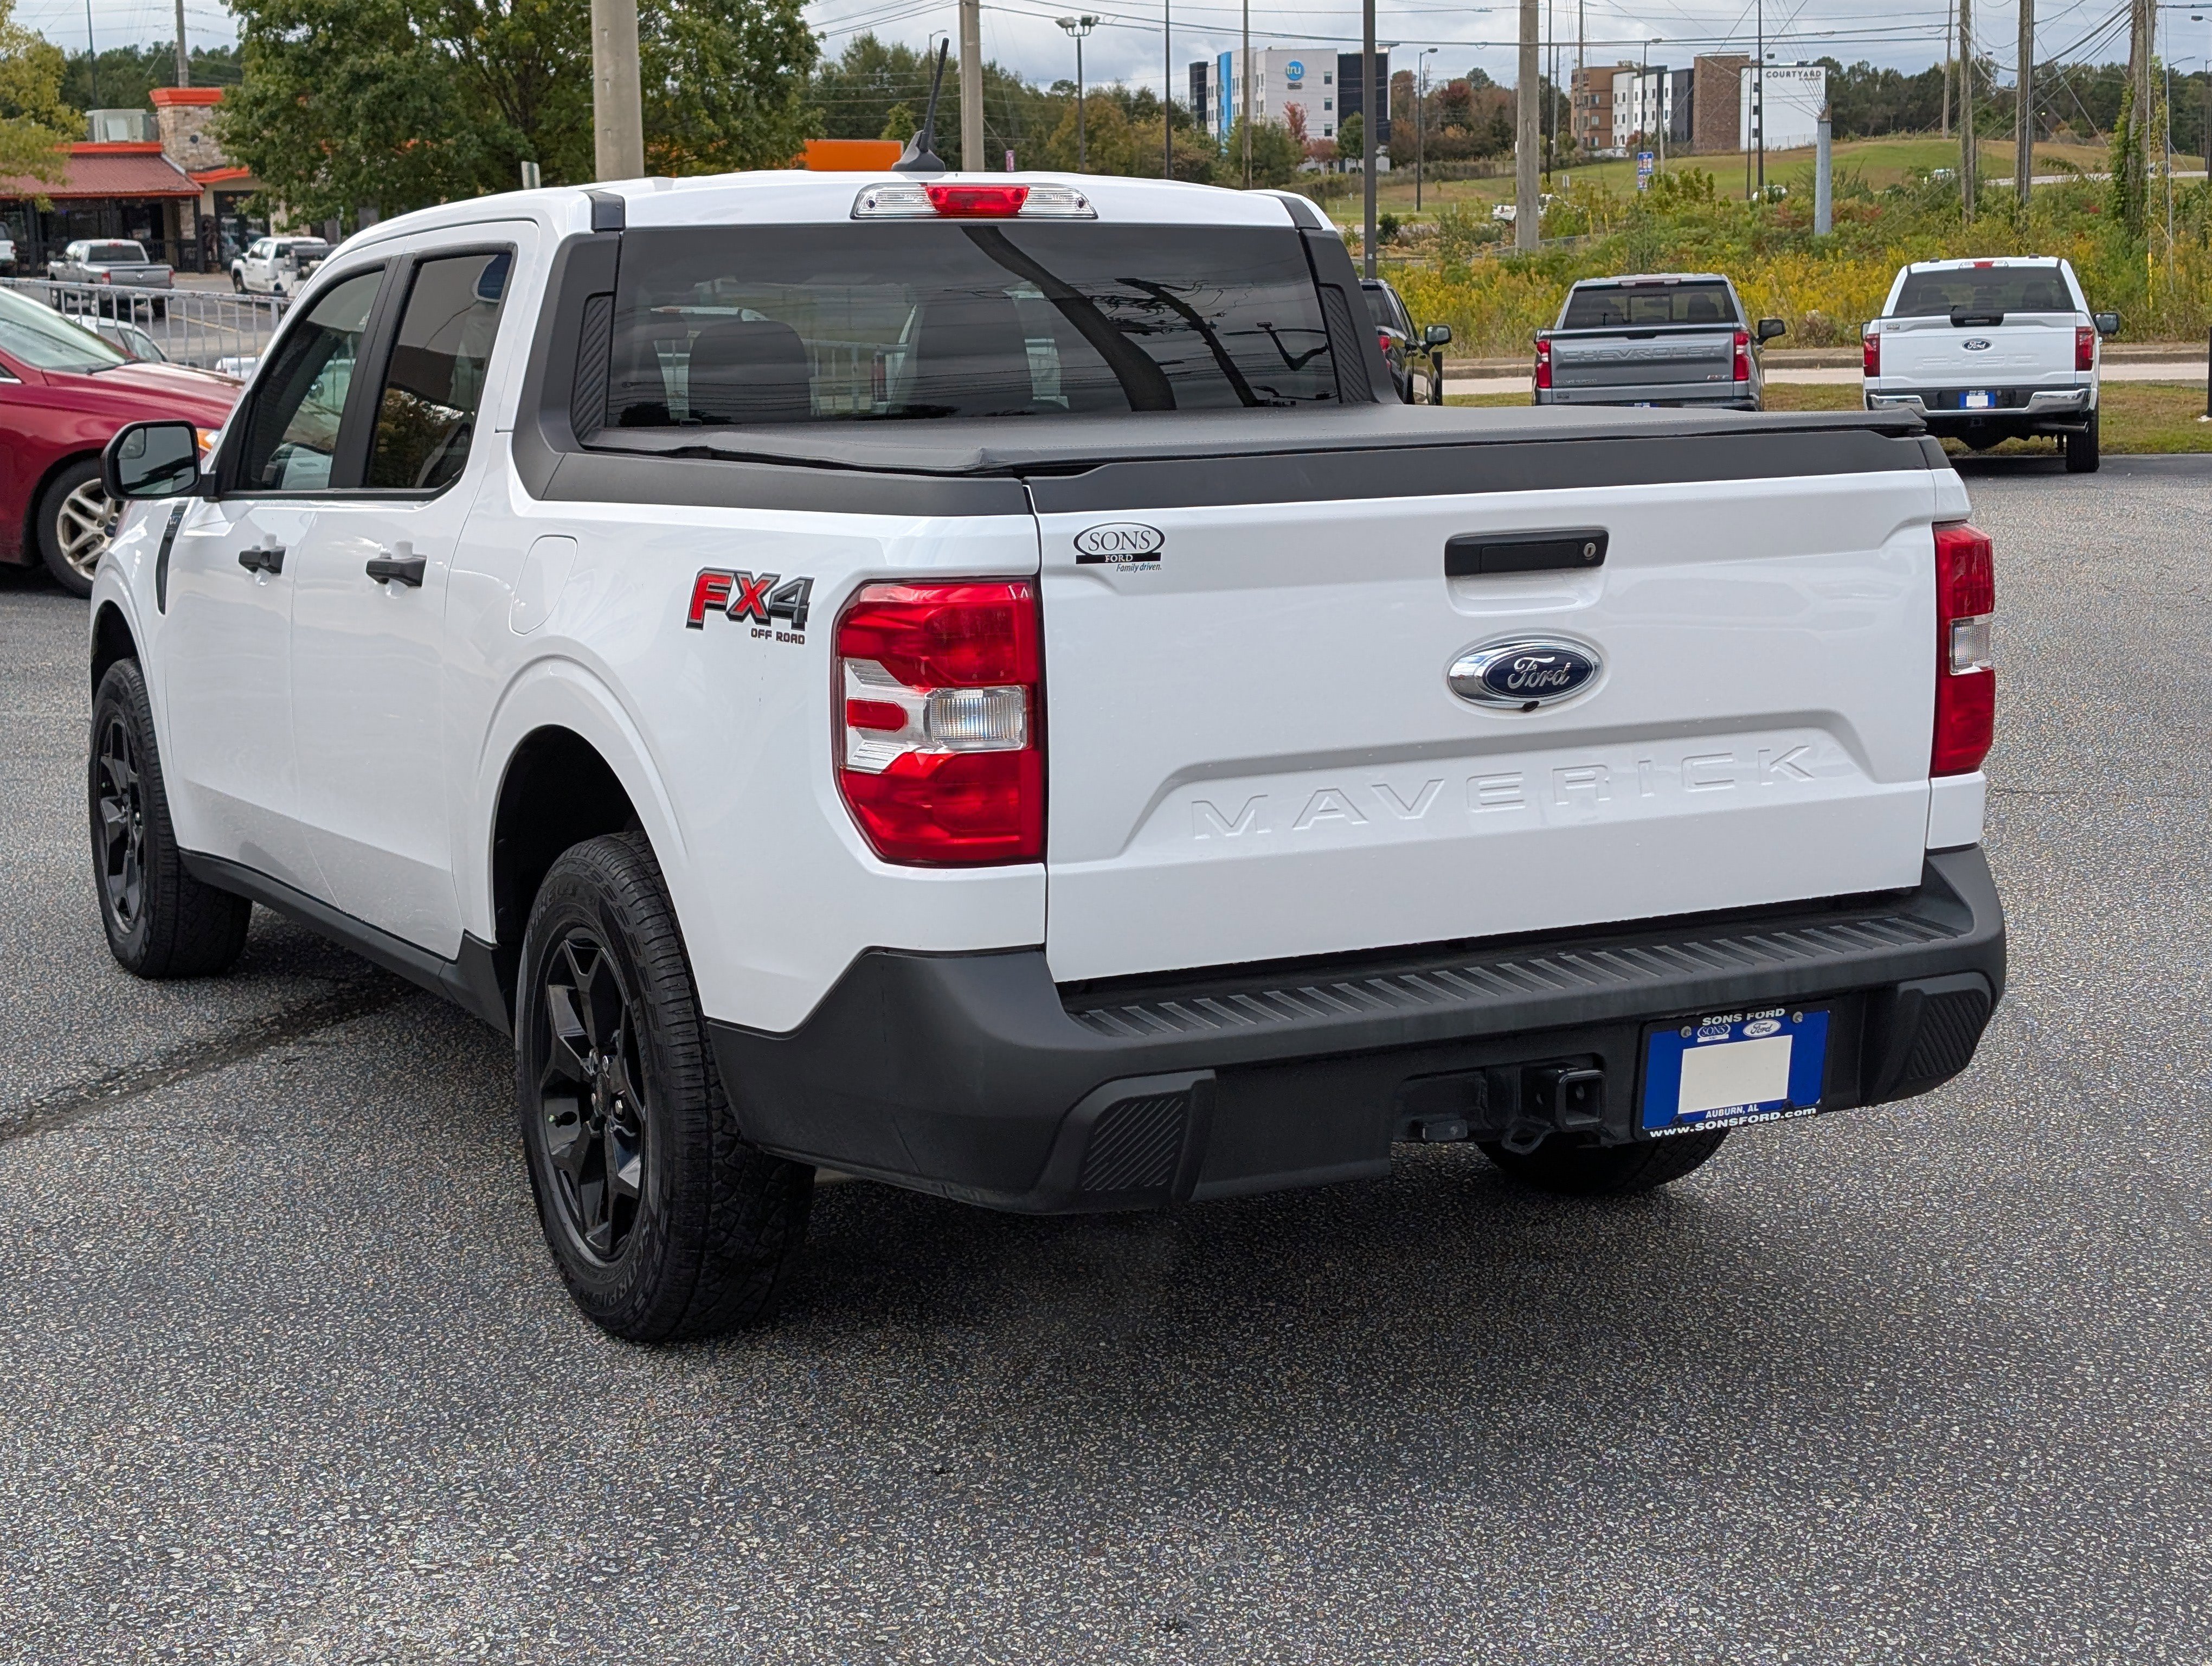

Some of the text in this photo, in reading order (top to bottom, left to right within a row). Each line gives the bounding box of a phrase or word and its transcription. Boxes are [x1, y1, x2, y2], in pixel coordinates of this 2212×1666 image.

[1287, 66, 1301, 74] tru
[1766, 70, 1821, 78] COURTYARD
[1967, 340, 1986, 349] Ford
[1563, 346, 1721, 362] CHEVROLET
[1088, 530, 1151, 552] SONS
[1104, 554, 1133, 562] FORD
[1116, 563, 1162, 573] Family driven.
[685, 566, 815, 631] FX4
[751, 628, 805, 645] OFF ROAD
[1507, 656, 1571, 689] Ford
[1191, 745, 1816, 840] MAVERICK
[1702, 1008, 1785, 1026] SONS FORD
[1701, 1024, 1726, 1036] SONS
[1750, 1022, 1773, 1035] Ford
[1706, 1104, 1759, 1119] AUBURN, AL
[1649, 1107, 1817, 1138] www.SONSFORD.com
